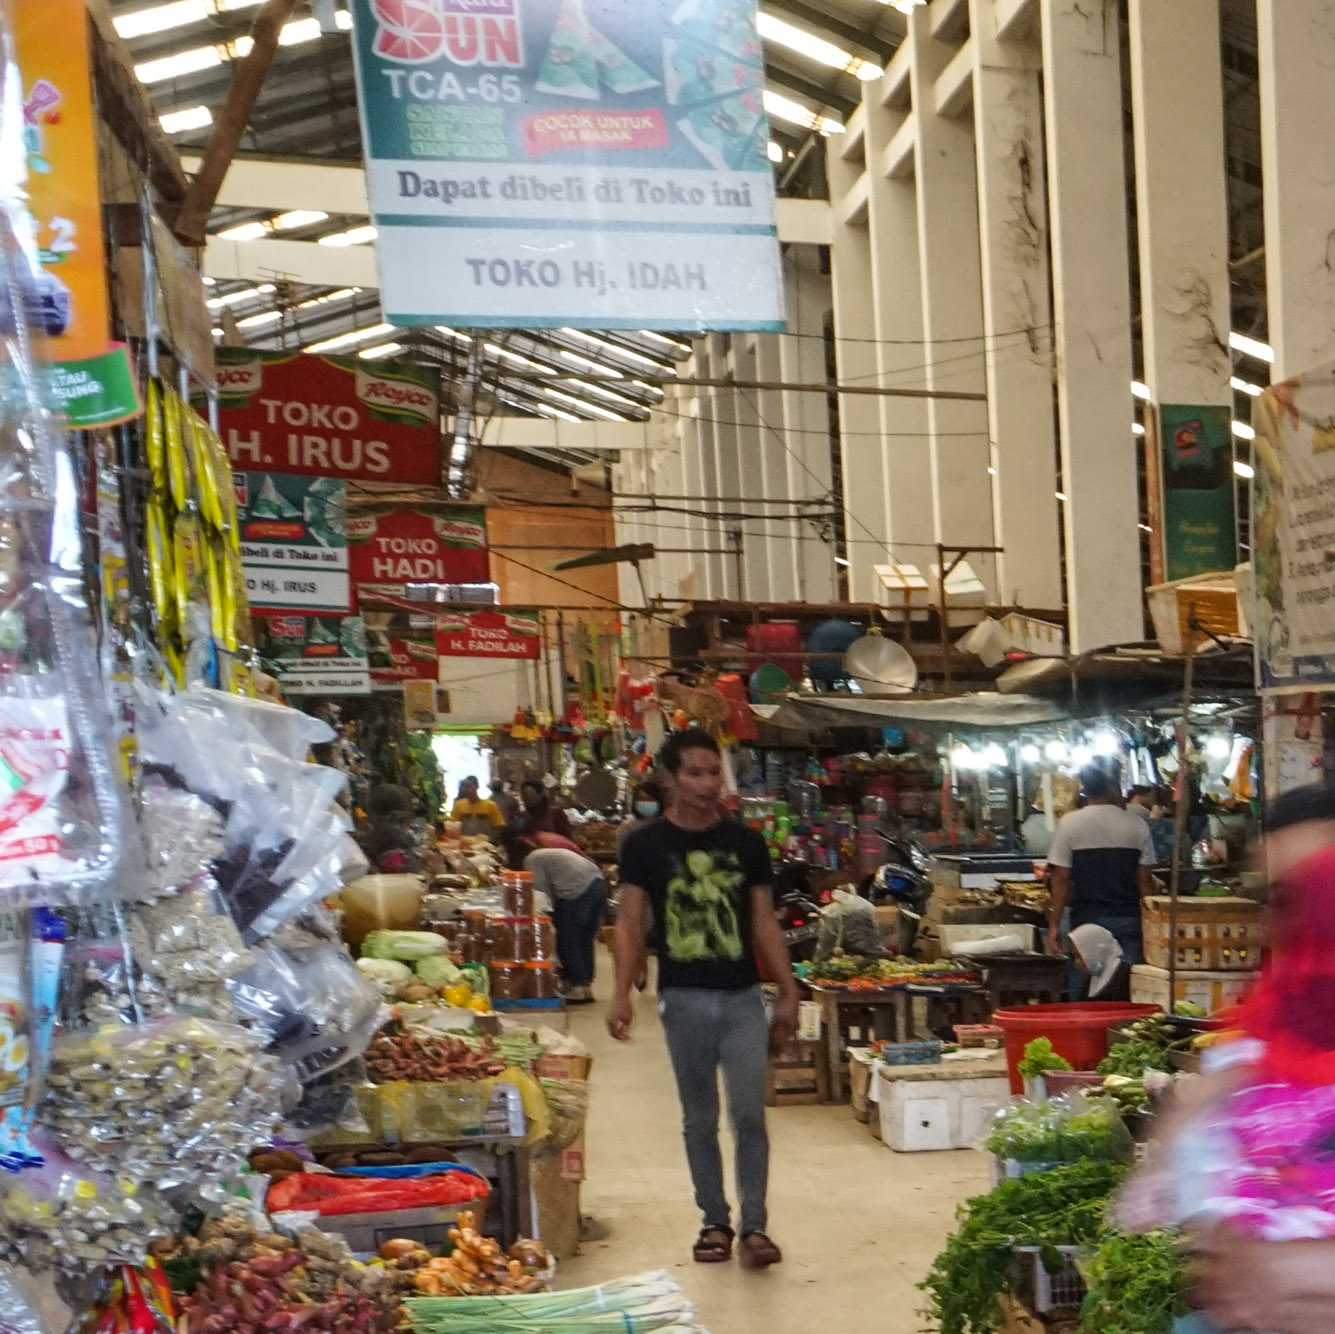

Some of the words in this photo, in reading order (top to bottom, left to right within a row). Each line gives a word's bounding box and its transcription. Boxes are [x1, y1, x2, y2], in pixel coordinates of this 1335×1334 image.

[381, 69, 522, 103] TCA-65
[533, 114, 593, 133] COCOK
[597, 115, 653, 131] UNTUK
[396, 169, 490, 204] Dapat
[500, 173, 585, 203] dibeli
[593, 176, 623, 203] di
[629, 179, 705, 205] Toko
[711, 181, 752, 208] ini
[465, 258, 560, 288] TOKO
[573, 261, 617, 297] Hj.
[629, 263, 707, 291] IDAH
[260, 398, 360, 431] TOKO
[228, 428, 273, 463] H.
[287, 433, 391, 473] IRUS
[375, 537, 438, 555] TOKO
[372, 557, 445, 580] HADI
[284, 581, 317, 593] IRUS
[468, 627, 509, 640] TOKO
[468, 639, 529, 653] FADILAH
